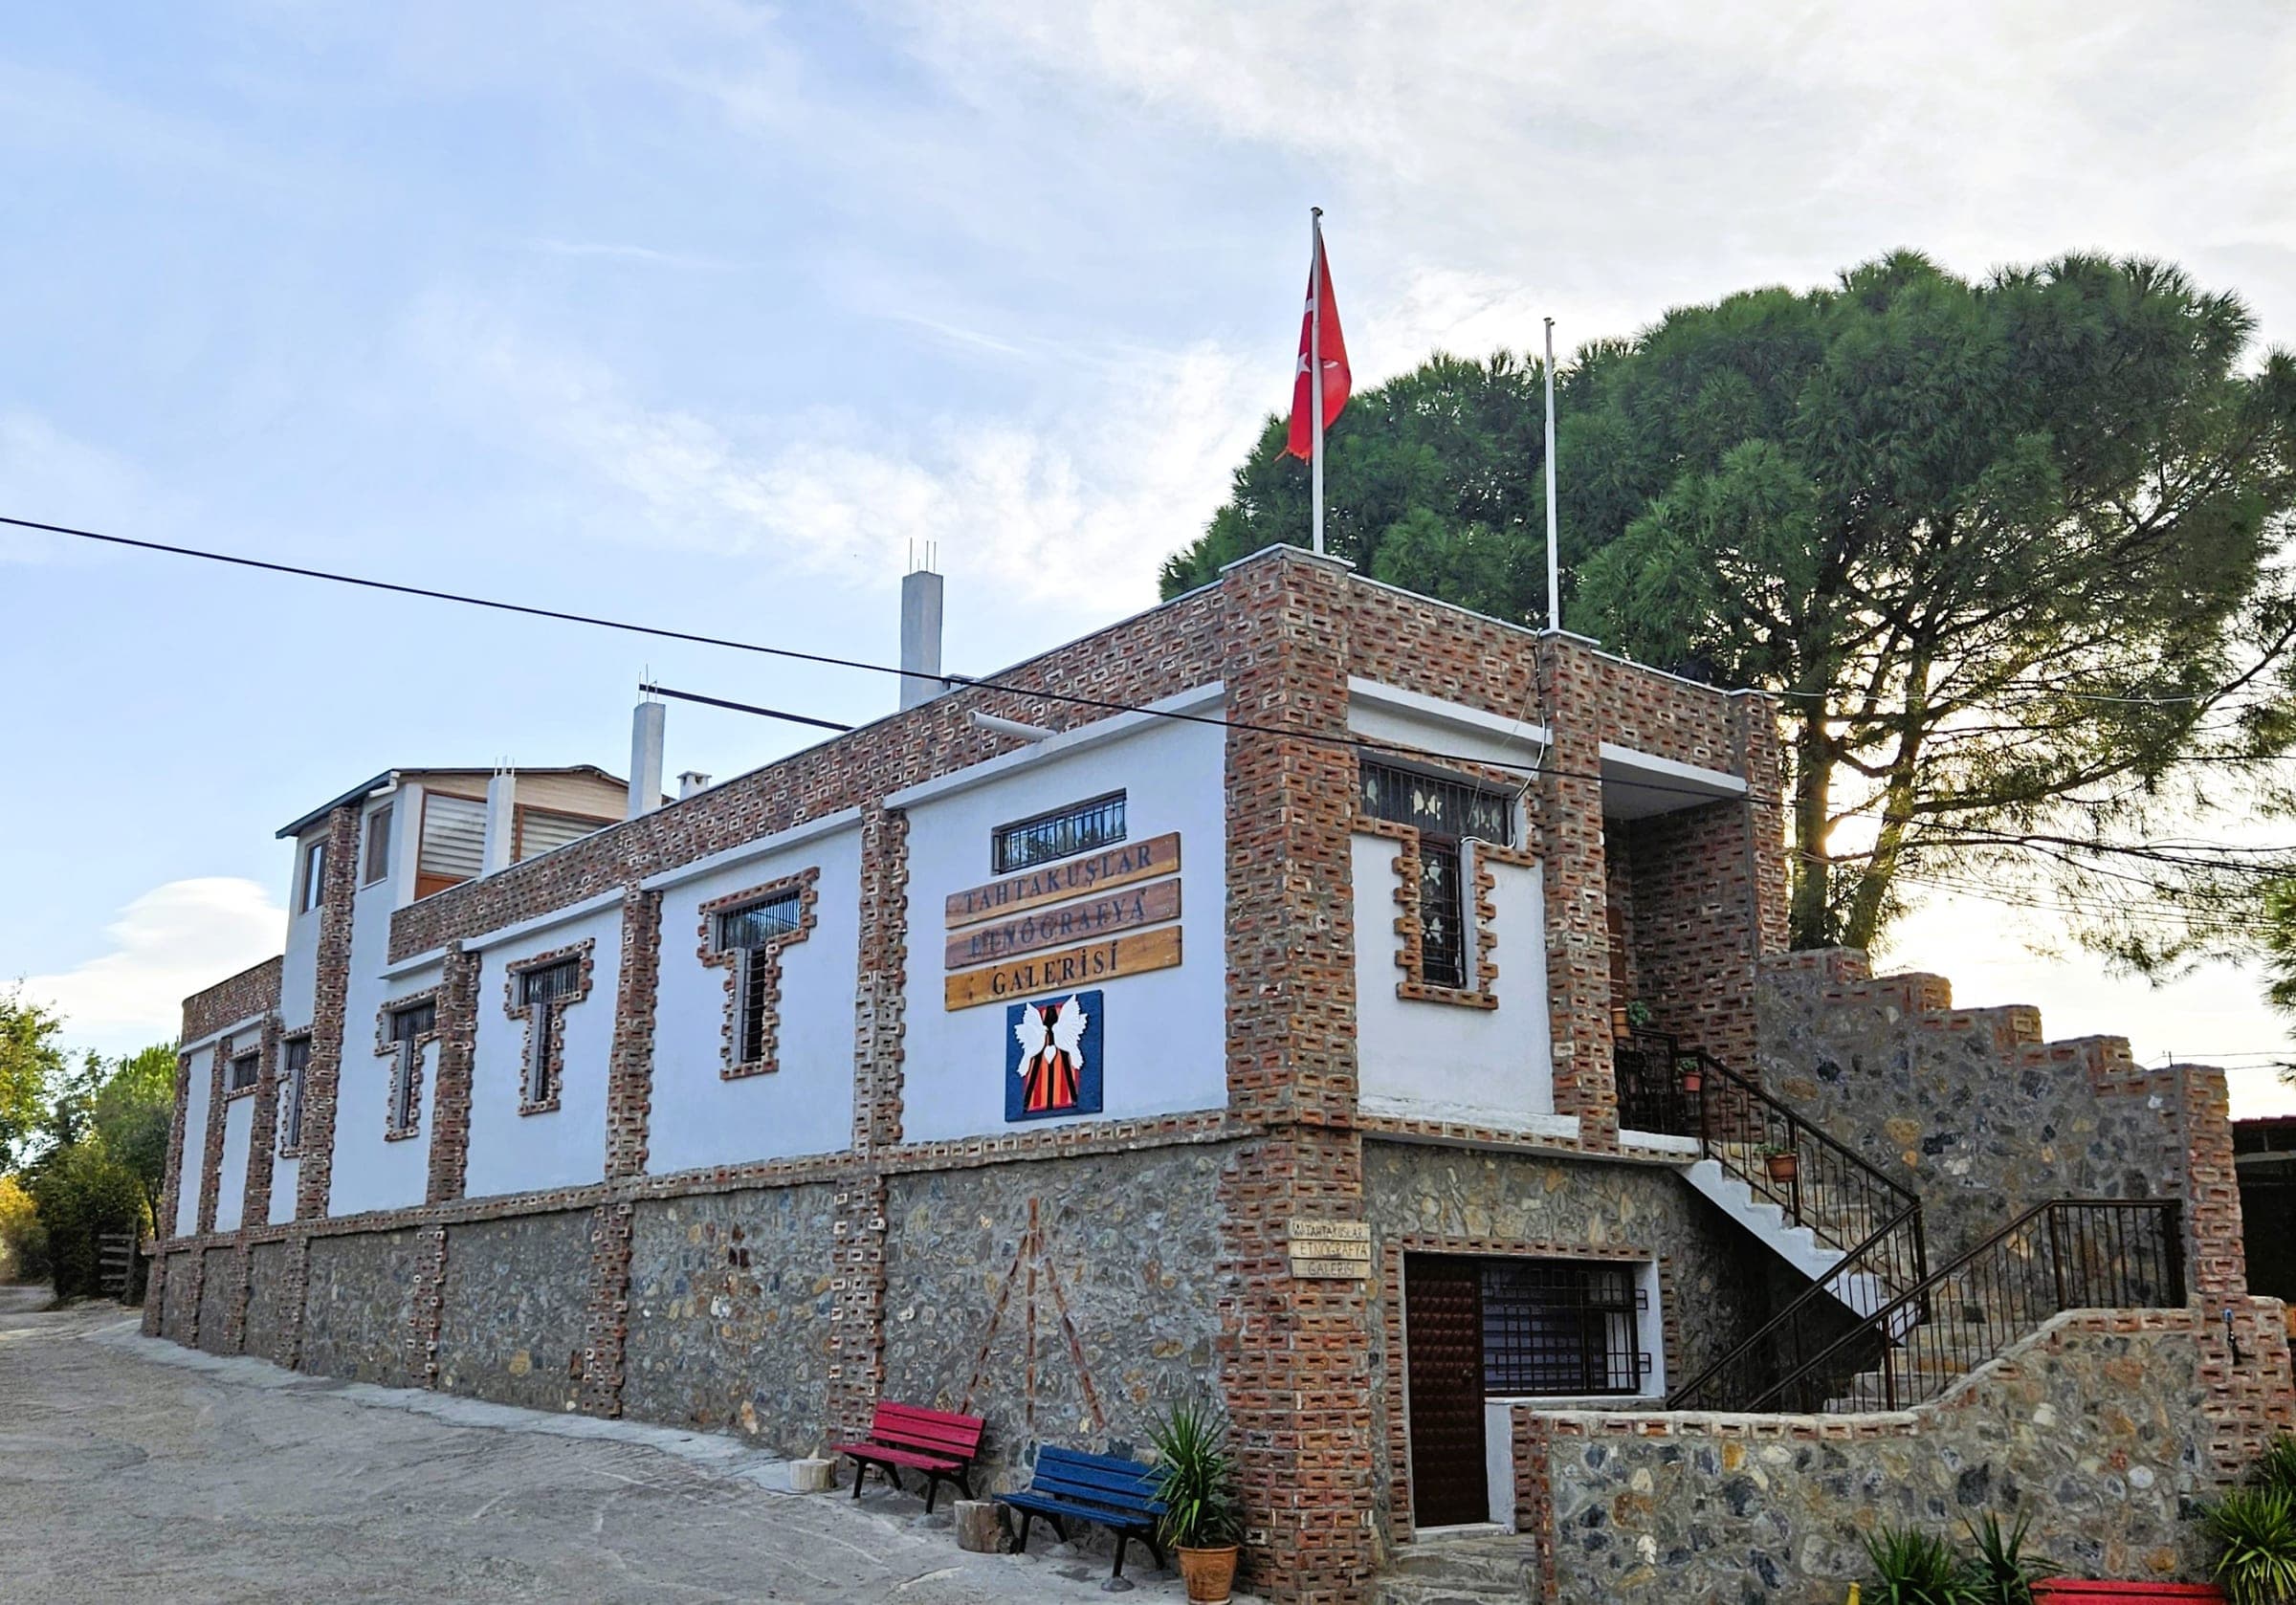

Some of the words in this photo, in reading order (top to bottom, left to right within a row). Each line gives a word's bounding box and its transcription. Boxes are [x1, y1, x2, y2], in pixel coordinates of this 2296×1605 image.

[964, 845, 1153, 913] TAHTAKUŞLAR
[970, 896, 1145, 957] ETNOGRAFYA
[992, 939, 1118, 995] GALERİSİ
[1300, 1242, 1367, 1257] ETNOGRAFYA
